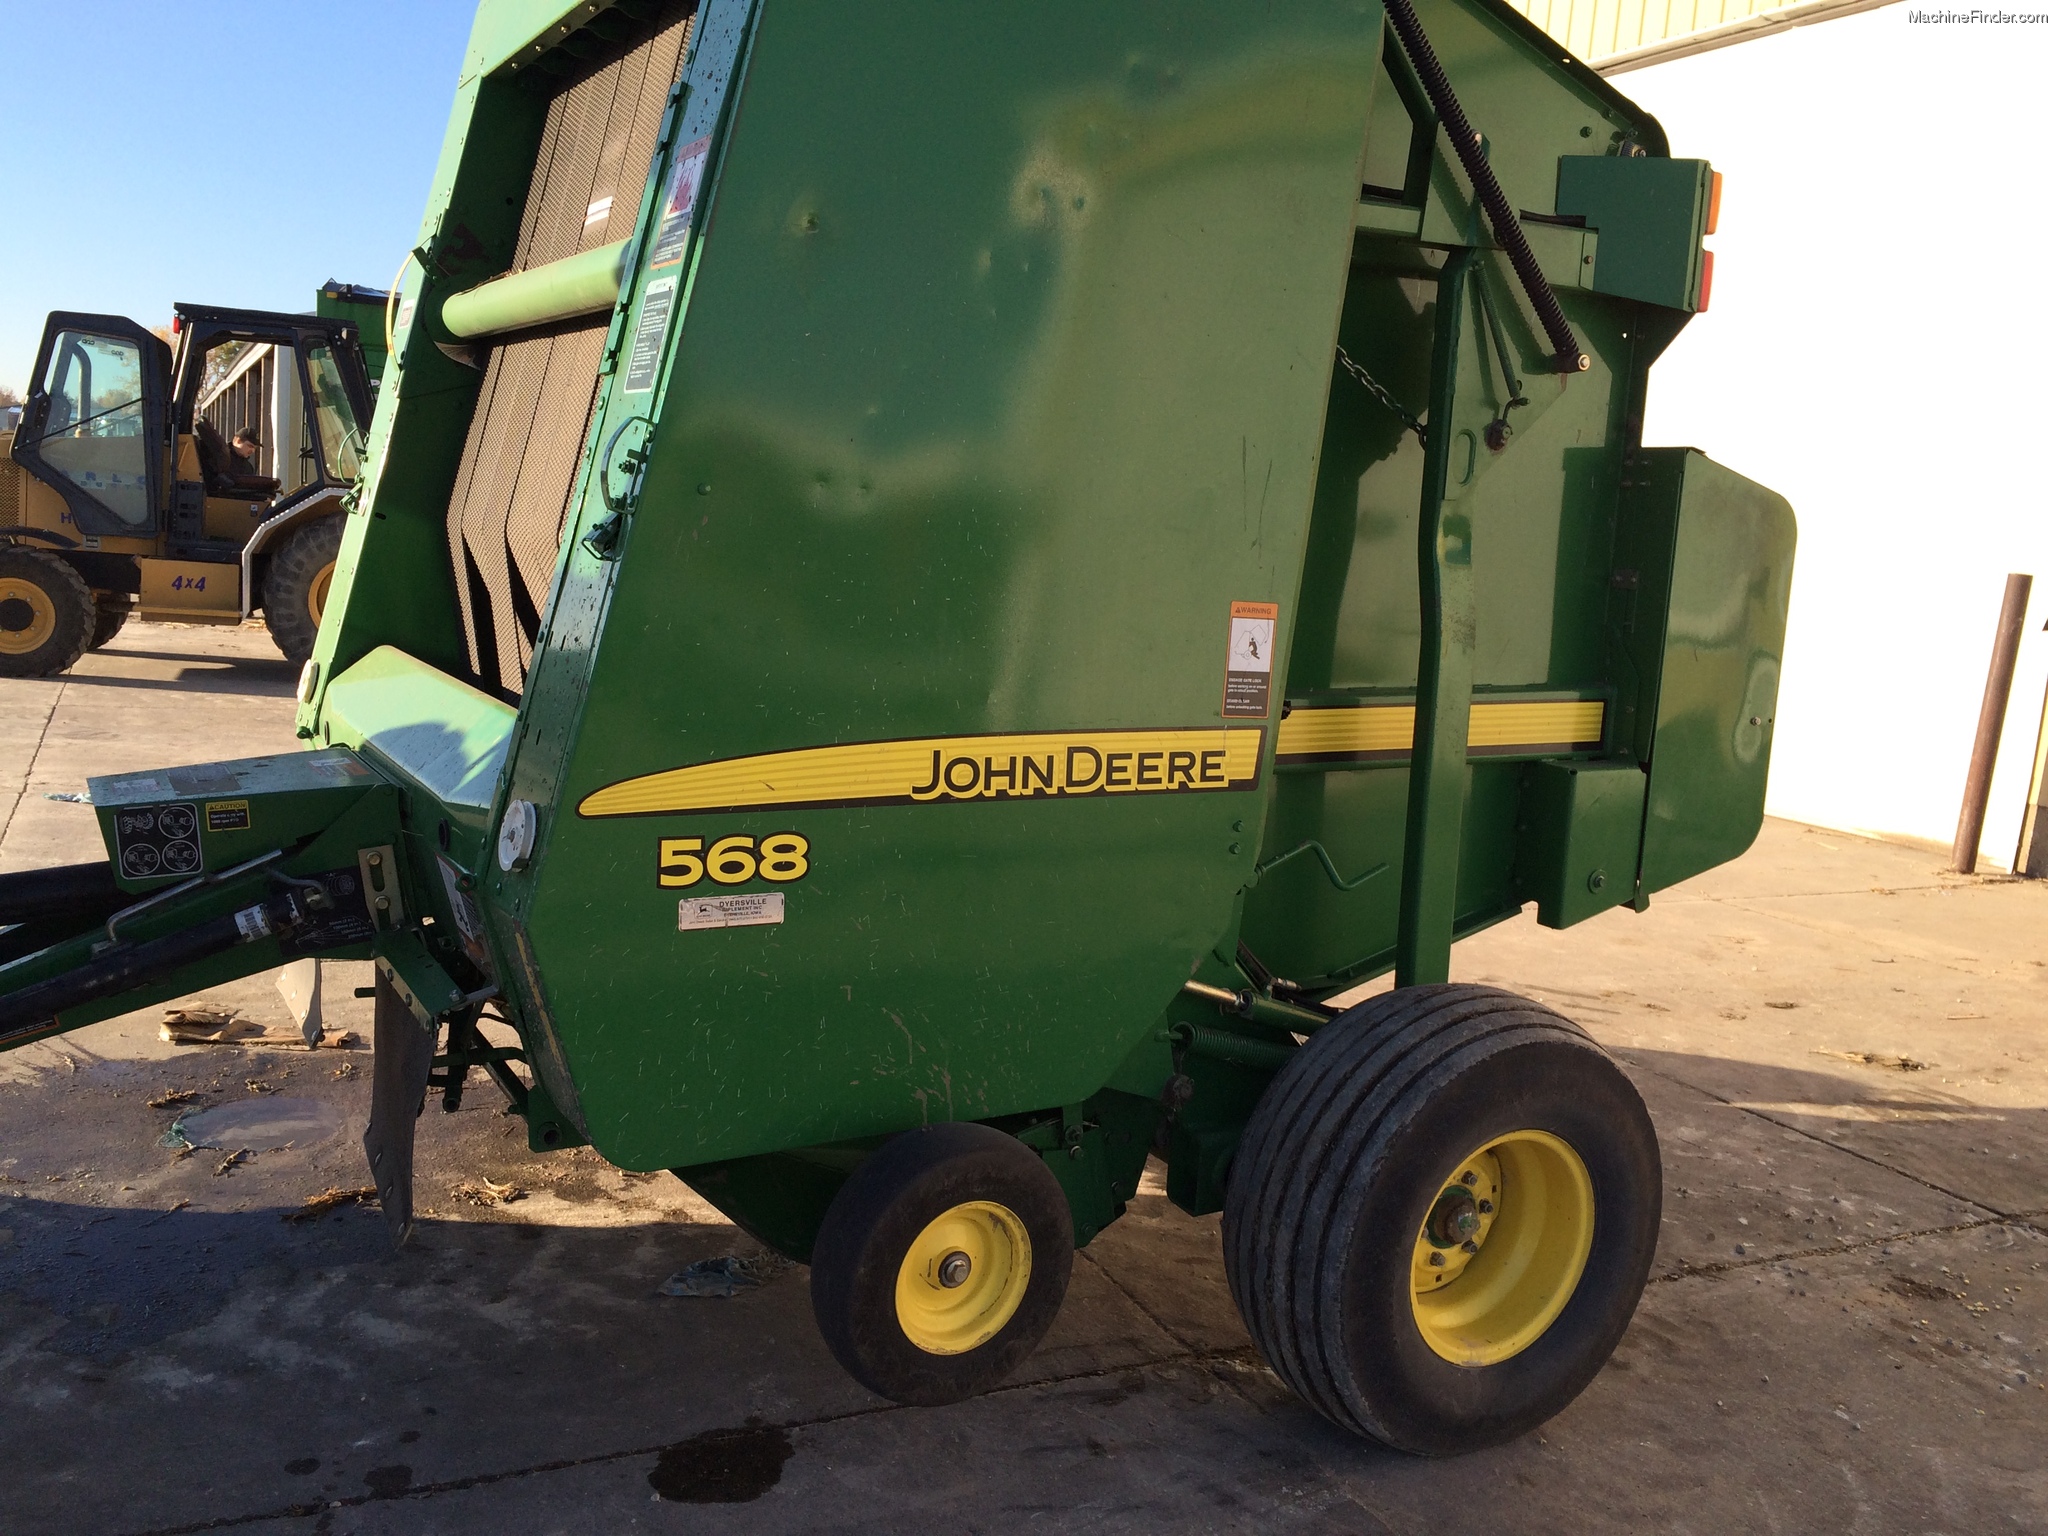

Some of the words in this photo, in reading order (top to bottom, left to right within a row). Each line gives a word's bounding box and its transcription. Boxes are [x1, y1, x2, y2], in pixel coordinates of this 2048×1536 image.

[1240, 606, 1271, 615] WARNING
[911, 750, 1054, 795] JOHN
[1065, 746, 1226, 788] DEERE
[214, 802, 246, 810] CAUTION
[657, 831, 811, 890] 568
[719, 898, 767, 908] DYERSVILLE
